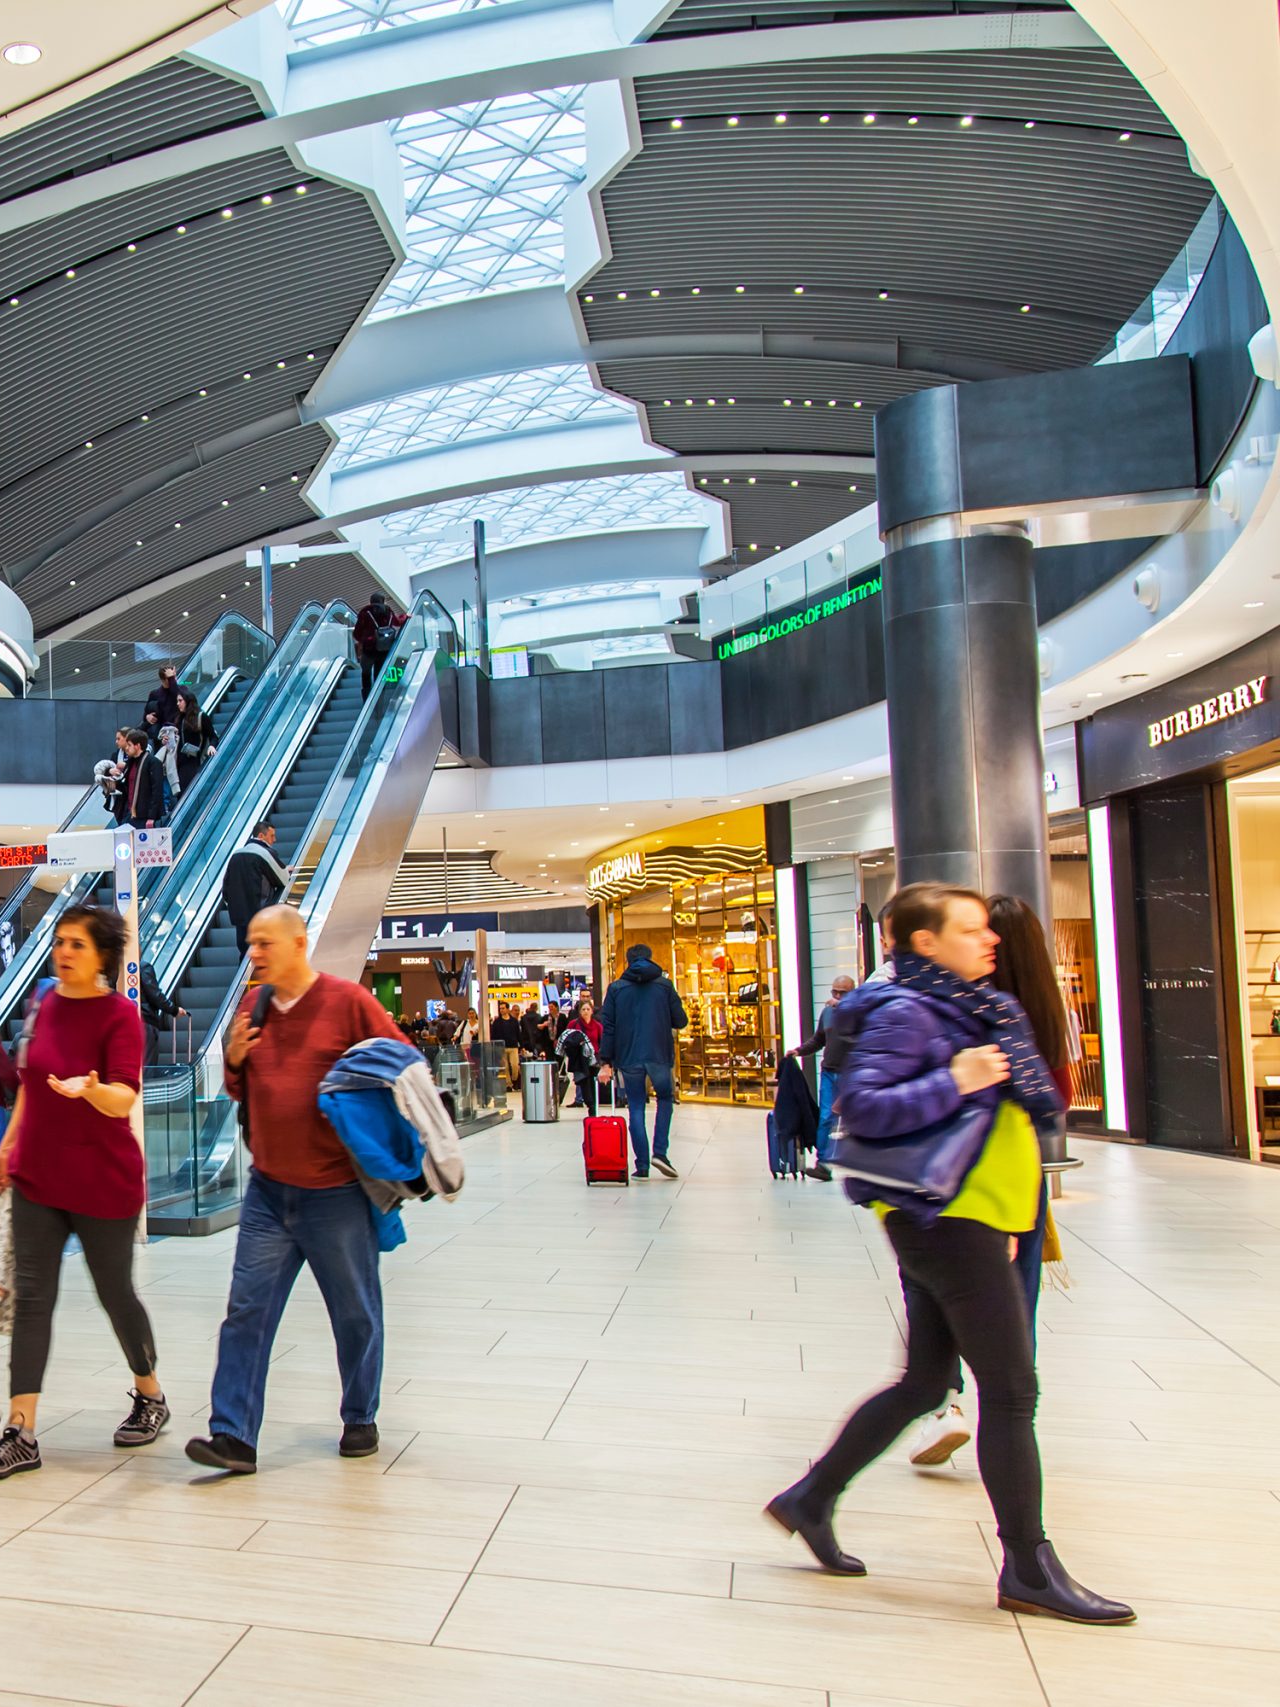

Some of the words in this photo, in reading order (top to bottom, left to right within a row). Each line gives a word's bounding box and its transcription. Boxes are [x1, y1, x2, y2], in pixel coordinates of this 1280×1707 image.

[718, 632, 758, 660] UNITED
[759, 613, 805, 645] COLORS
[805, 604, 822, 625] OF
[1148, 675, 1266, 747] BURBERRY
[0, 855, 33, 867] CARTS
[16, 844, 48, 856] S.P.A.
